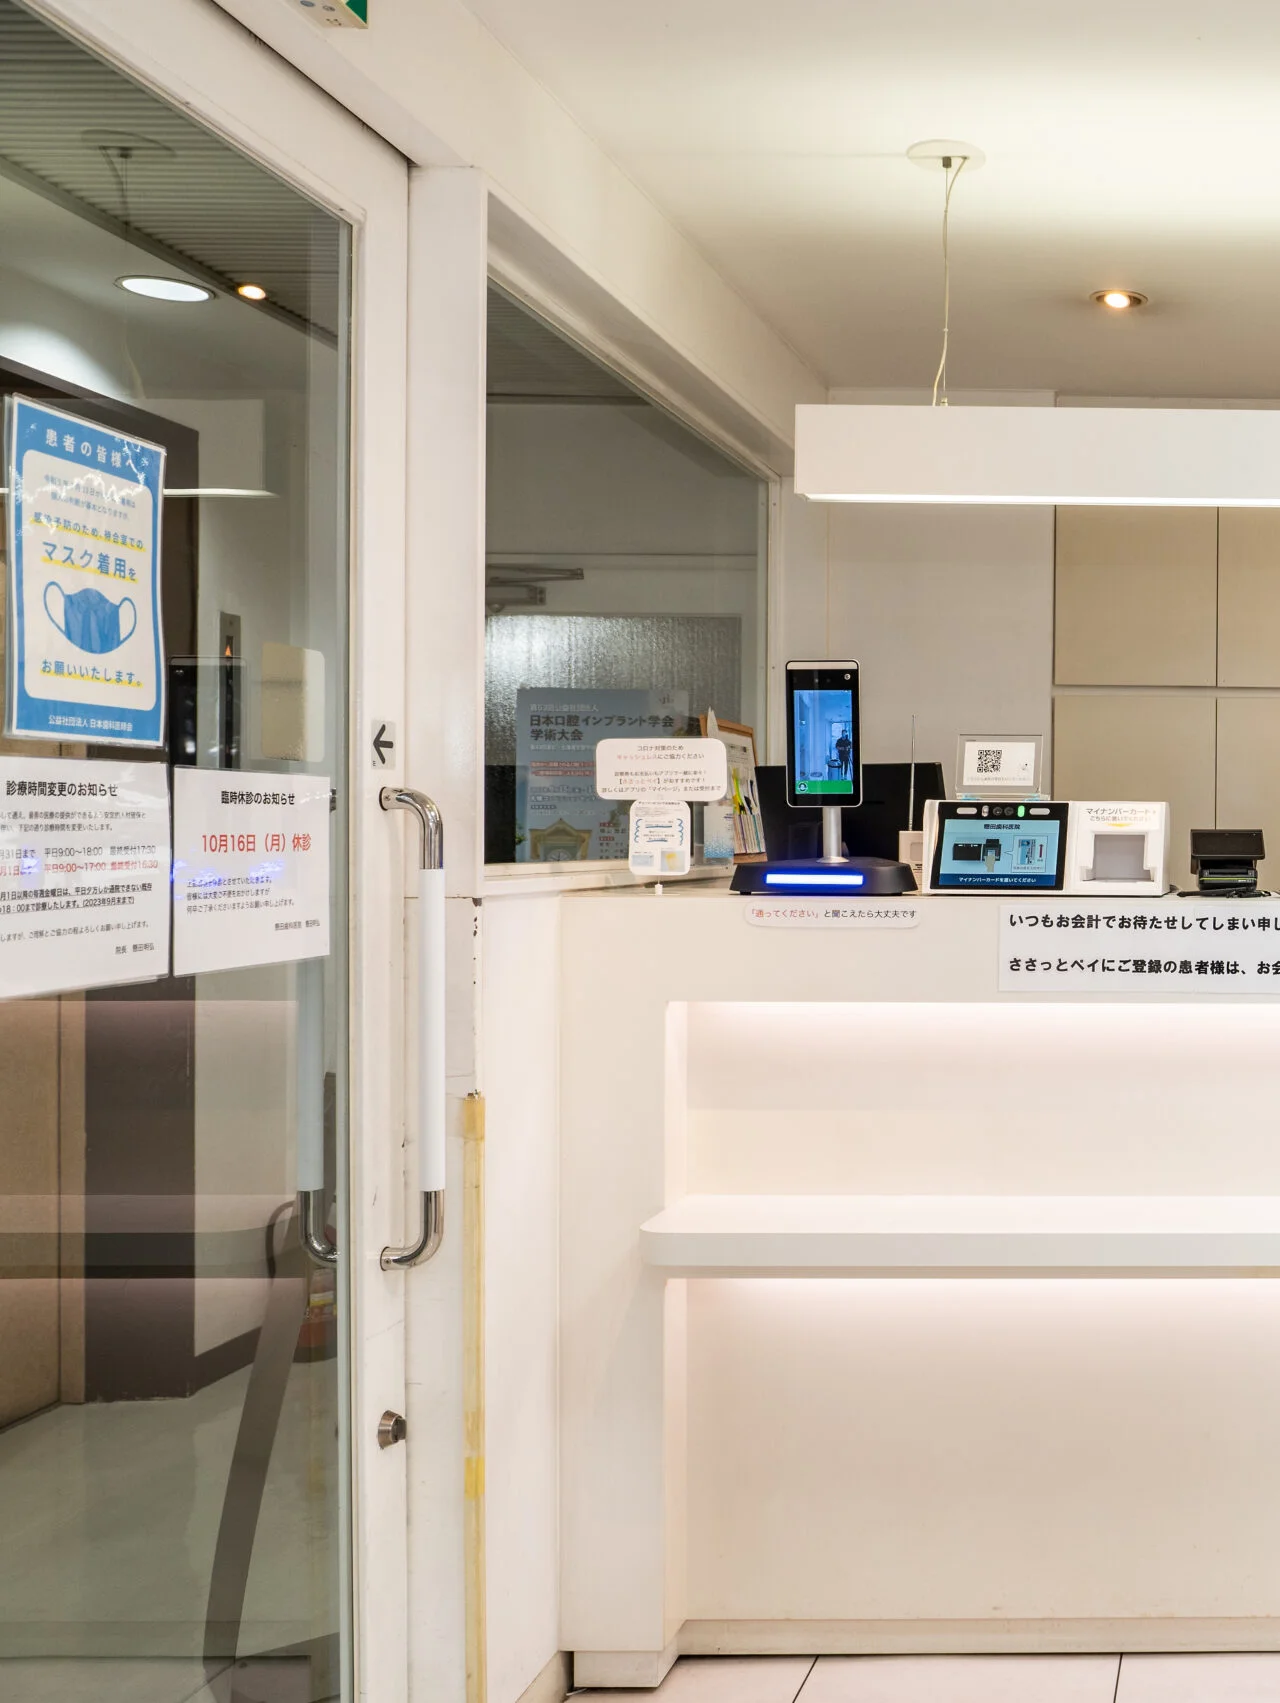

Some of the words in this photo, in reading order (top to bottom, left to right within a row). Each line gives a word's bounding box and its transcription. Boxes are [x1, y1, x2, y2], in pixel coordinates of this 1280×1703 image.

[45, 427, 134, 468] 患者の皆様へ
[42, 541, 139, 583] マスク着用を
[41, 660, 141, 686] お願いいたします。
[529, 714, 675, 728] 日本口腔インプラント学会
[530, 729, 584, 741] 学術大会
[6, 780, 118, 797] 診療時間変更のお知らせ
[221, 789, 295, 806] 臨時休診のお知らせ
[202, 832, 312, 854] 10月16日（月）休診
